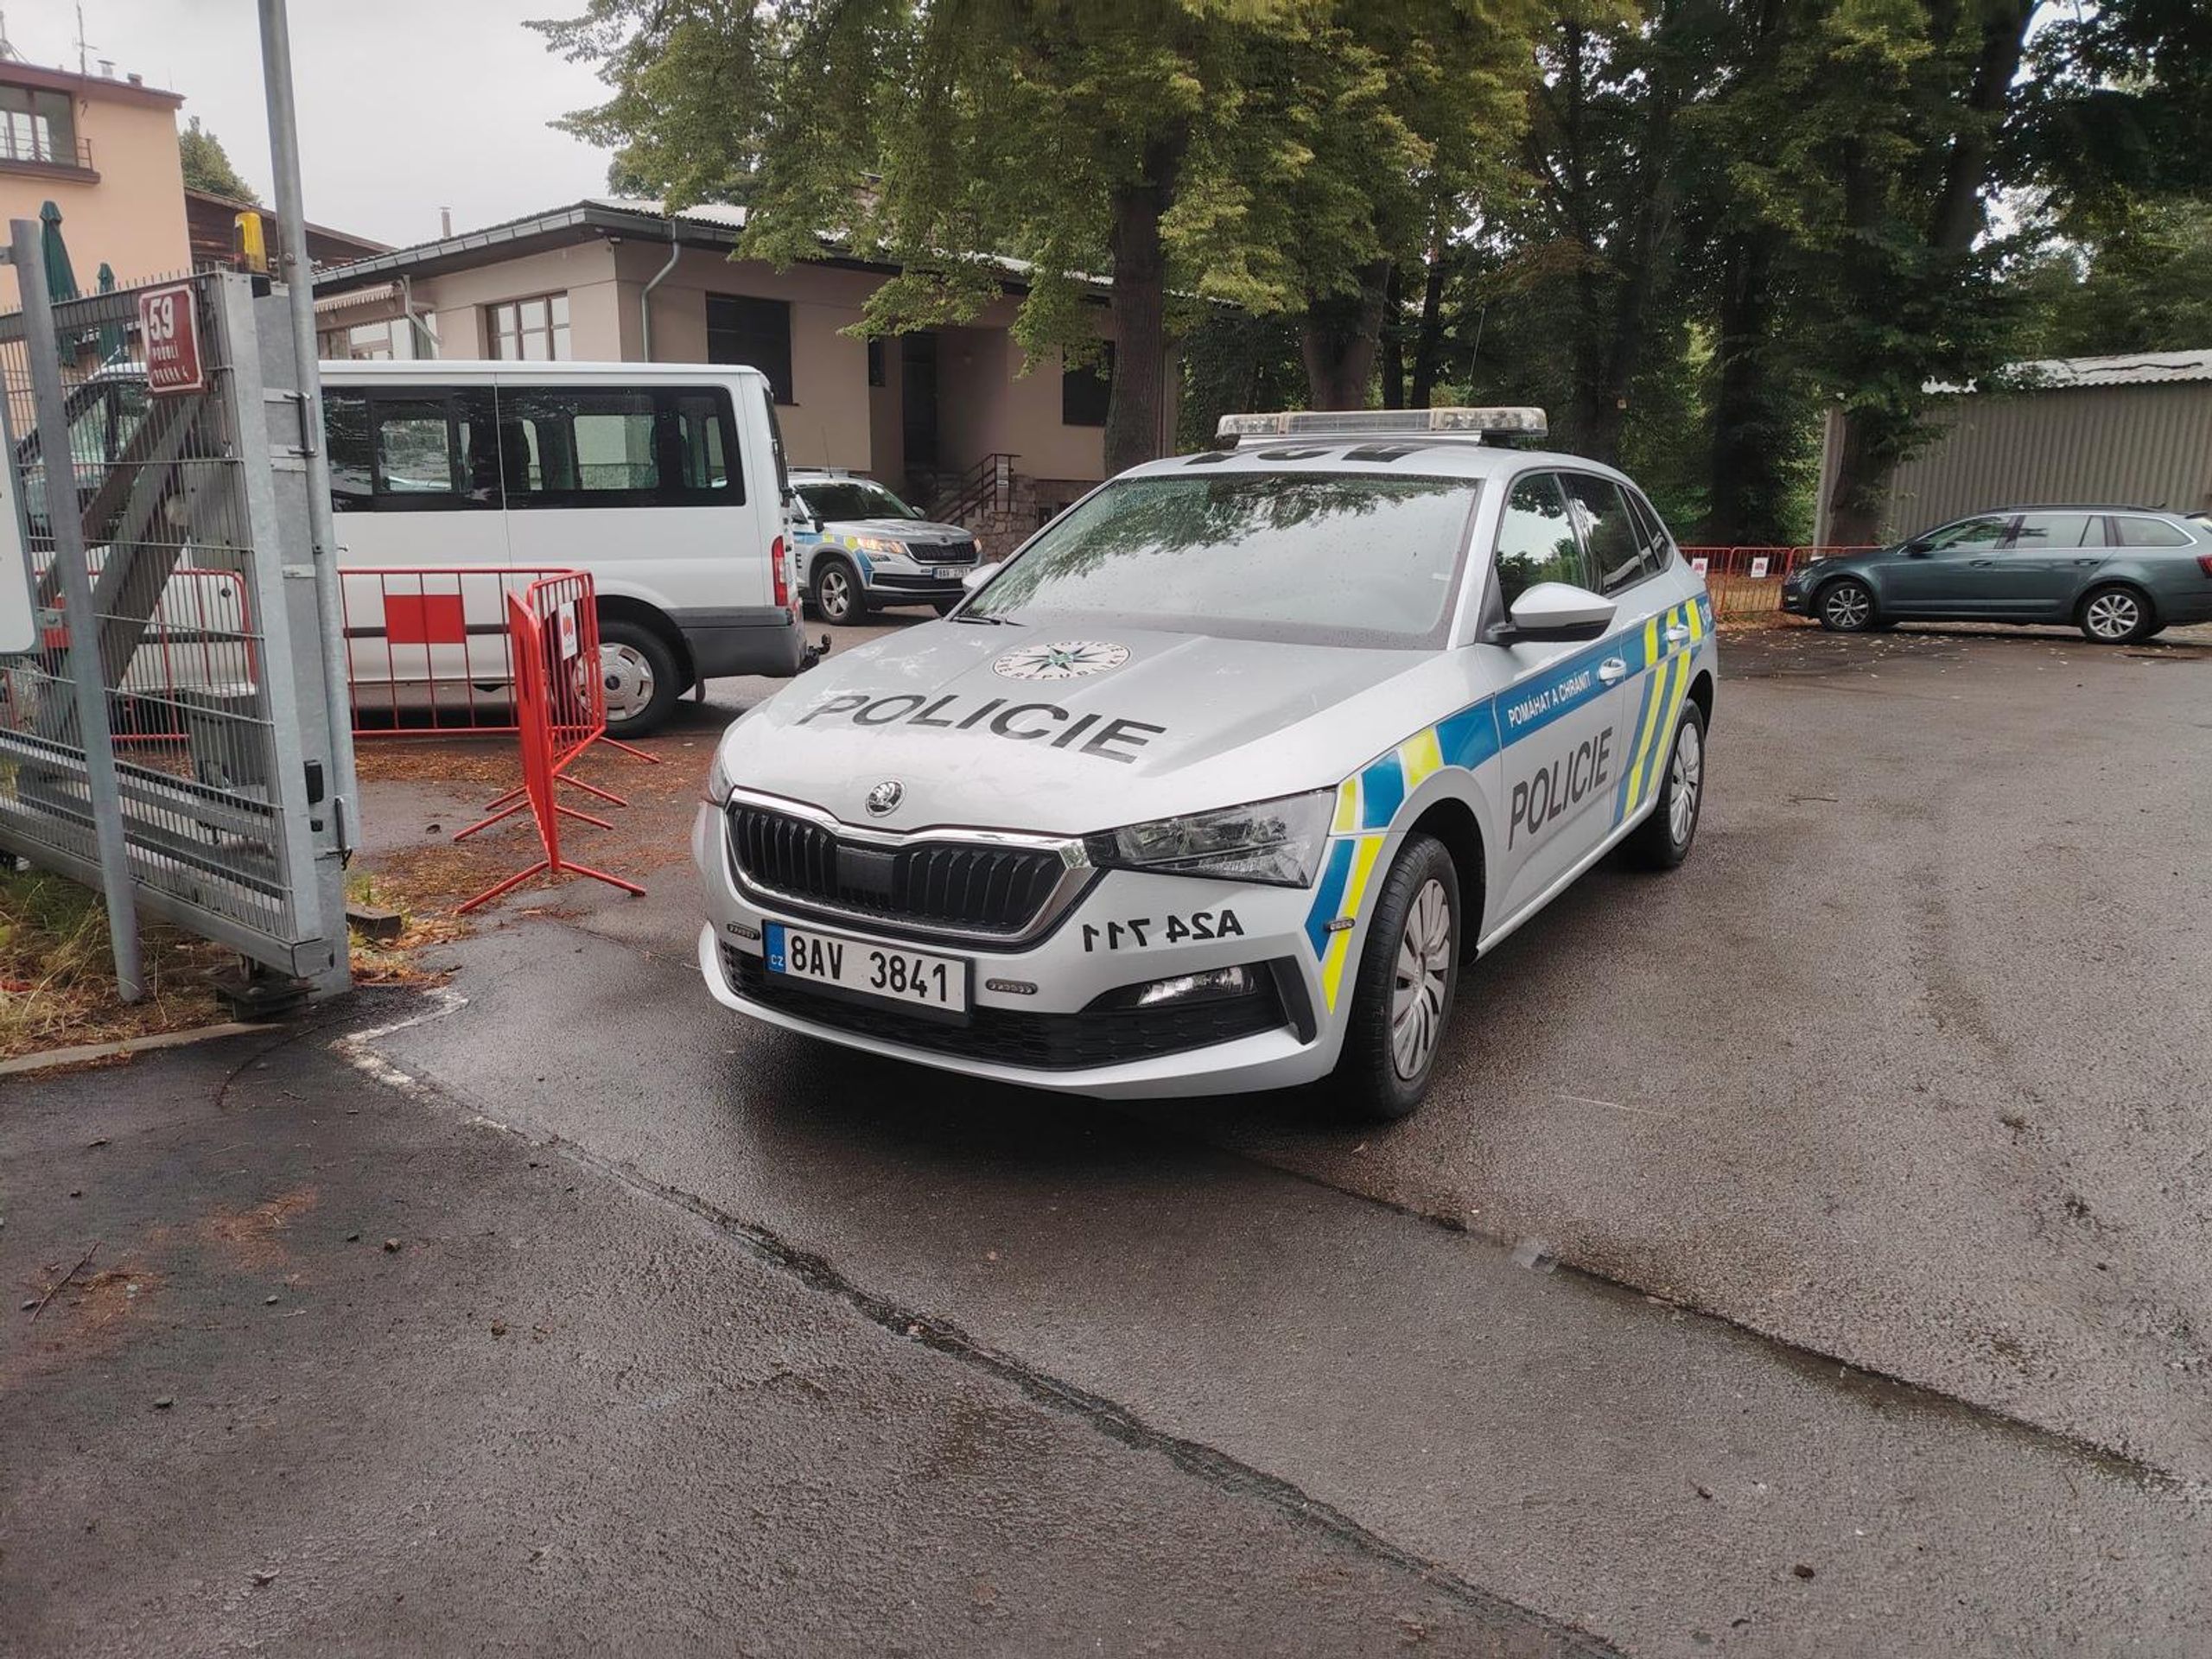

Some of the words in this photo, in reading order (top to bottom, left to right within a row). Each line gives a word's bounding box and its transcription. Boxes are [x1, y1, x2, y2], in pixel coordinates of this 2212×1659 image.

[149, 296, 175, 340] 59
[793, 694, 1166, 764] POLICIE
[1507, 692, 1551, 728] POMÁHAT
[1552, 688, 1559, 706] A
[1508, 726, 1613, 851] POLICIE
[771, 954, 784, 966] CZ
[791, 935, 843, 981] 8AV
[869, 951, 946, 1002] 3841
